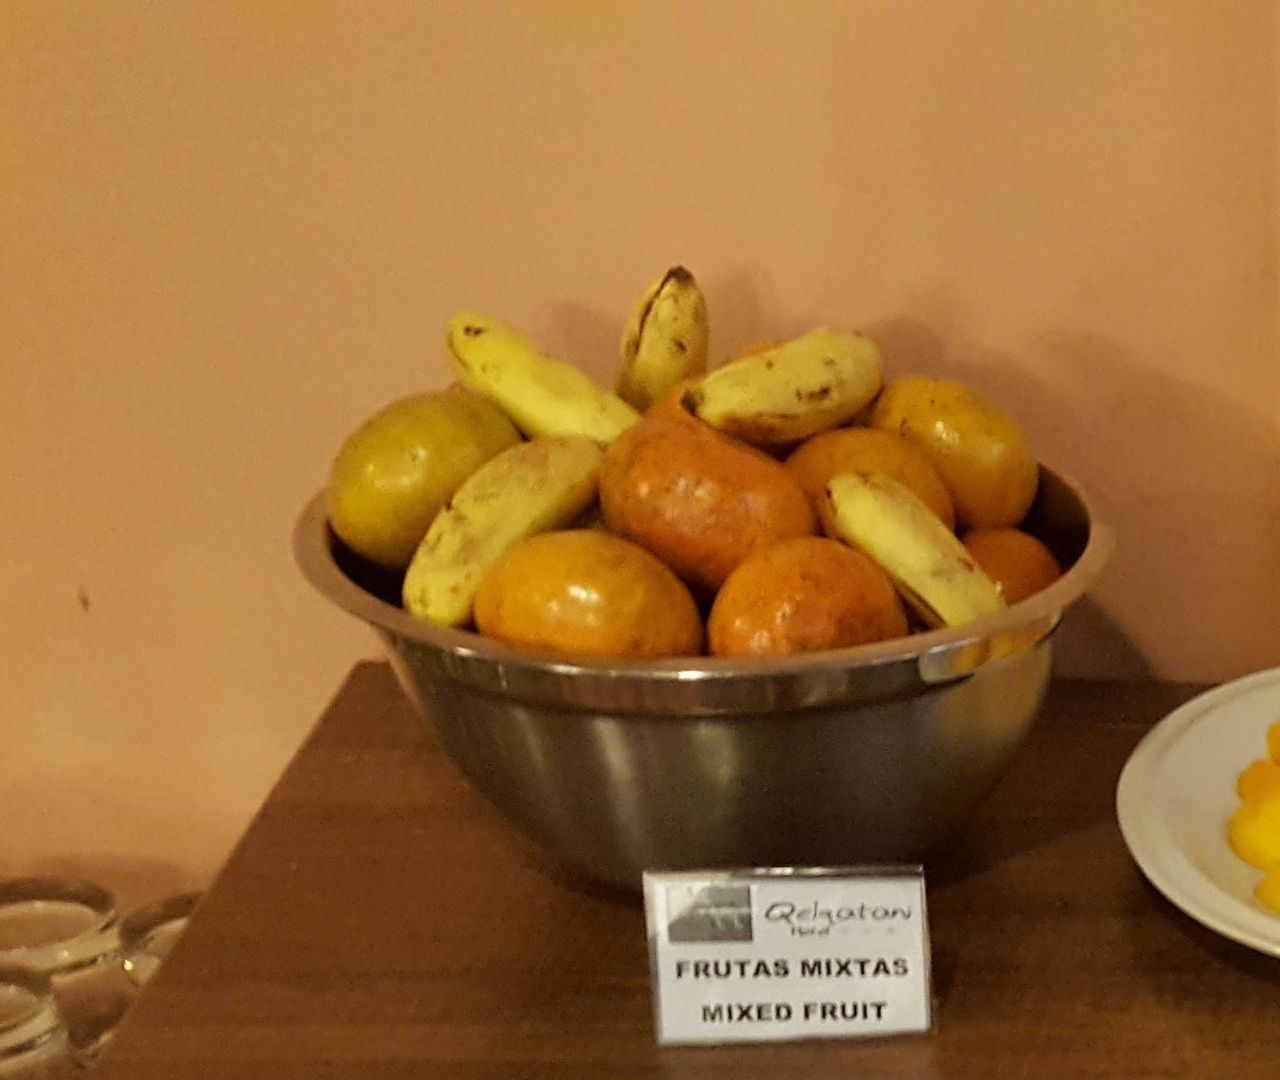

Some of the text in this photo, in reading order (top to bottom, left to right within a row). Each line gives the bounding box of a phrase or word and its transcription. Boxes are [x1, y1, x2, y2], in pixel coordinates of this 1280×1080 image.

[676, 958, 909, 979] FRUTAS MIXTAS
[702, 1002, 888, 1023] MIXED FRUIT
